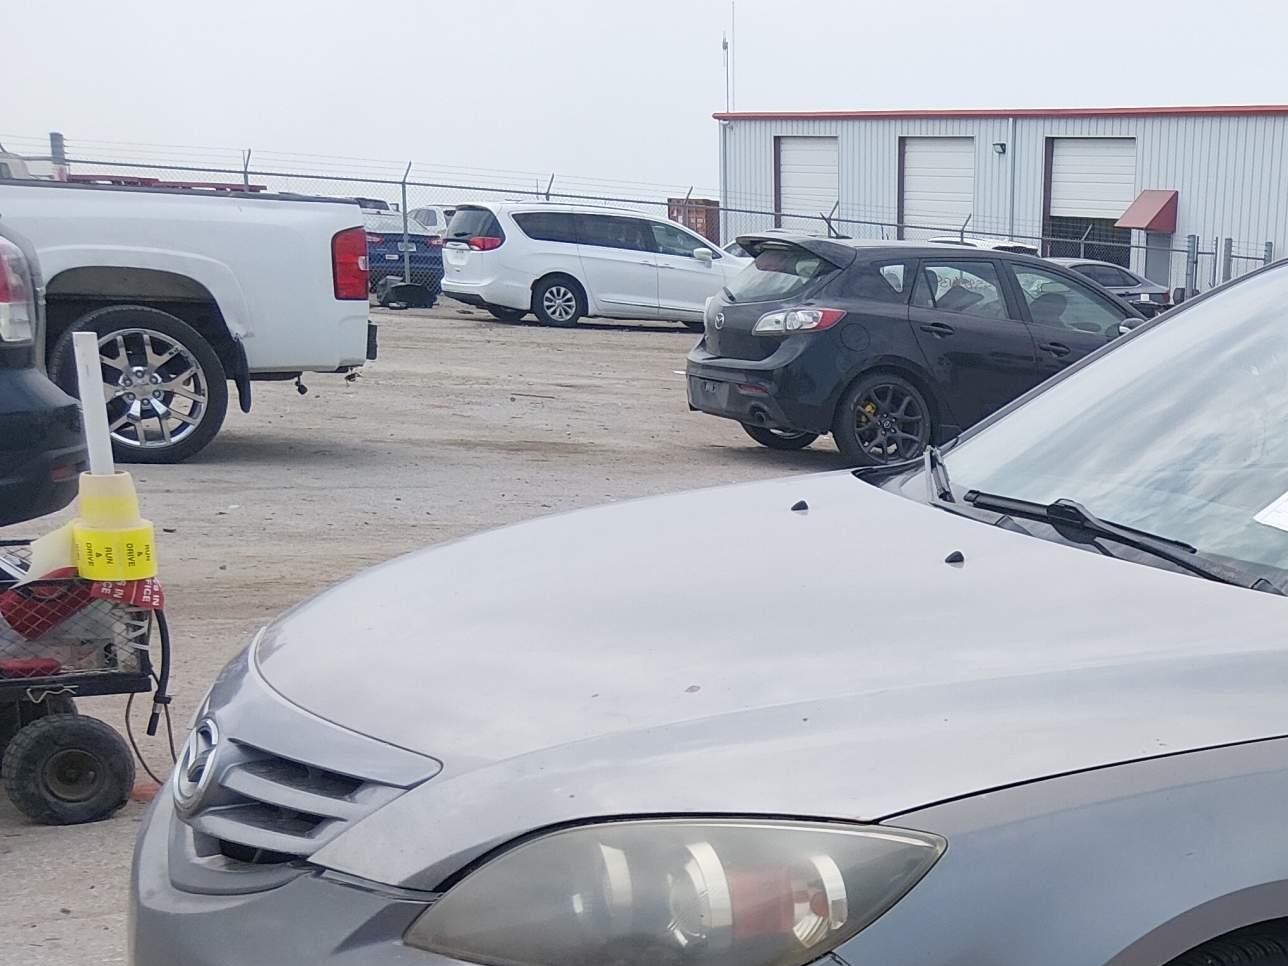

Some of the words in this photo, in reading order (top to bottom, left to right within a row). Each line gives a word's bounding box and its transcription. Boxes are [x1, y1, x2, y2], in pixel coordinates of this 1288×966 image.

[85, 542, 95, 567] DRIVE
[104, 546, 113, 565] RUN
[126, 543, 136, 568] DRIVE
